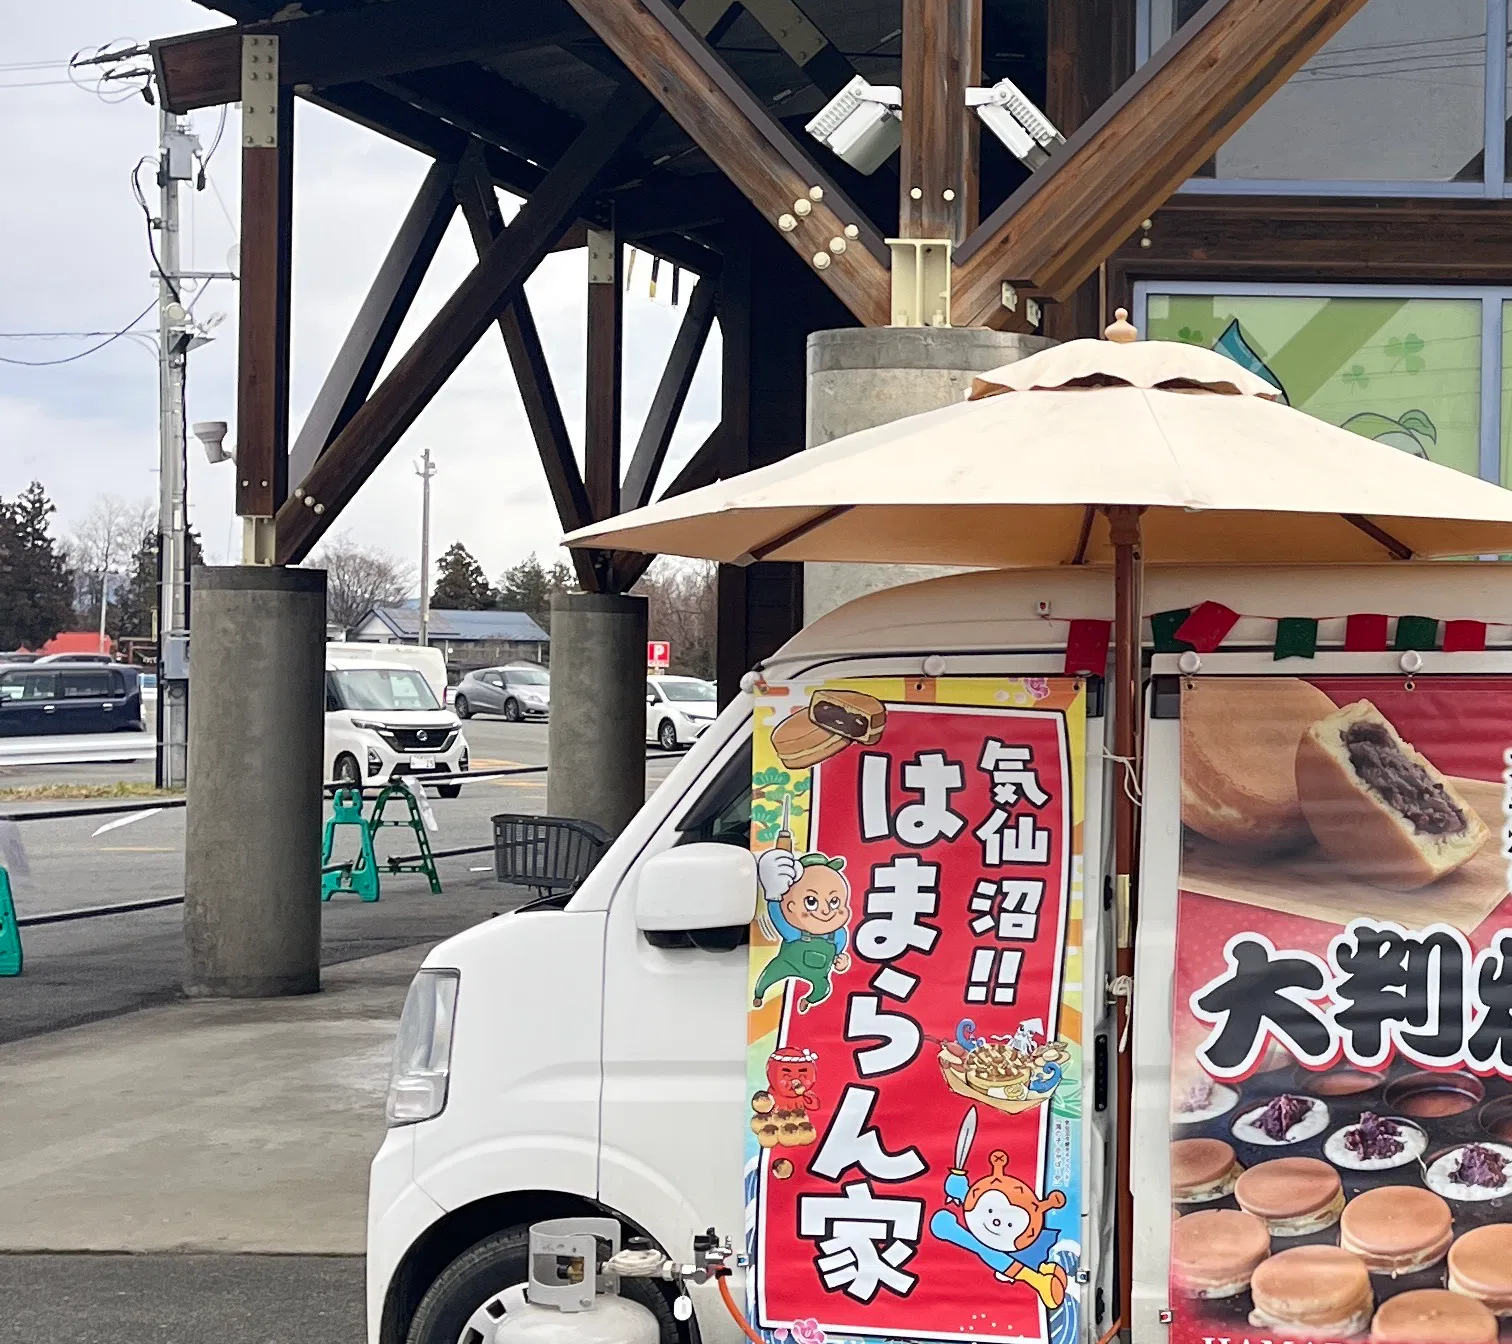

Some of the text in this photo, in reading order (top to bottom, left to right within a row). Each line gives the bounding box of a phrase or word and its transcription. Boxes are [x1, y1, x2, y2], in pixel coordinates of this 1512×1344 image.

[653, 644, 665, 660] P
[799, 747, 965, 1305] はまらん家
